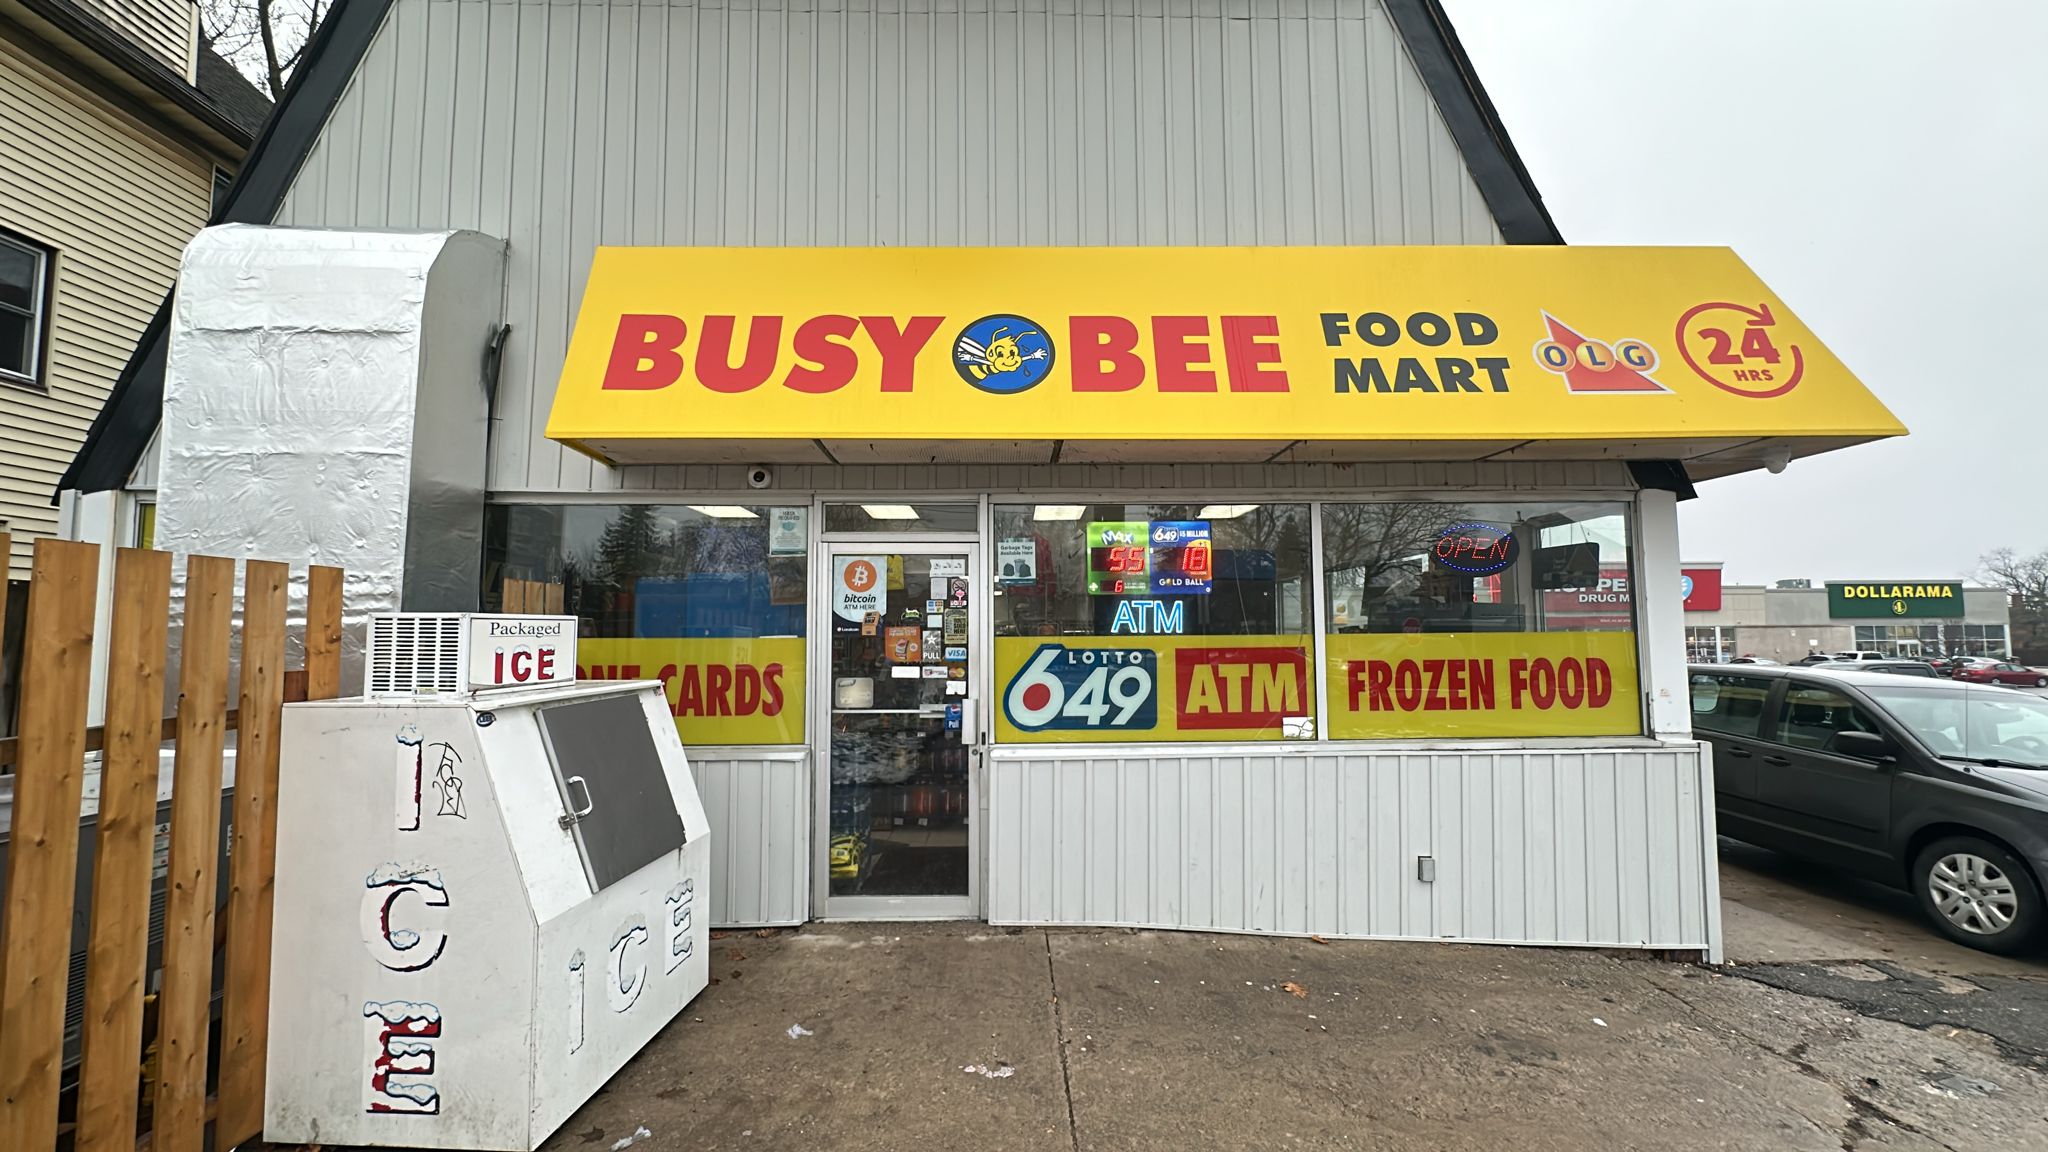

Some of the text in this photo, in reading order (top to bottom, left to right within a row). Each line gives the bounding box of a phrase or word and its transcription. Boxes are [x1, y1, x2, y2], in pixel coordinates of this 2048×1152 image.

[1320, 312, 1499, 347] FOOD
[602, 314, 1290, 393] BUSY BEE
[1543, 344, 1648, 368] OLG
[1699, 327, 1780, 365] 24
[1334, 357, 1511, 393] MART
[1733, 368, 1774, 382] HRS
[1101, 530, 1134, 545] MAX
[1155, 527, 1176, 542] 649
[1109, 546, 1145, 572] 55
[1182, 546, 1208, 572] 18
[1436, 536, 1512, 560] OPEN
[1185, 578, 1204, 586] BALL
[1844, 585, 1953, 598] DOLLARAMA
[844, 594, 876, 603] bitcoin
[1579, 594, 1616, 603] DRUG
[1111, 600, 1183, 634] ATM
[489, 621, 561, 638] Packaged
[494, 644, 556, 684] ICE
[923, 652, 940, 660] PULL
[1068, 651, 1144, 665] LOTTO
[657, 663, 784, 718] CARDS
[1008, 649, 1152, 727] 649
[1185, 663, 1300, 714] ATM
[1347, 657, 1612, 712] FROZEN FOOD
[948, 720, 959, 729] Pull
